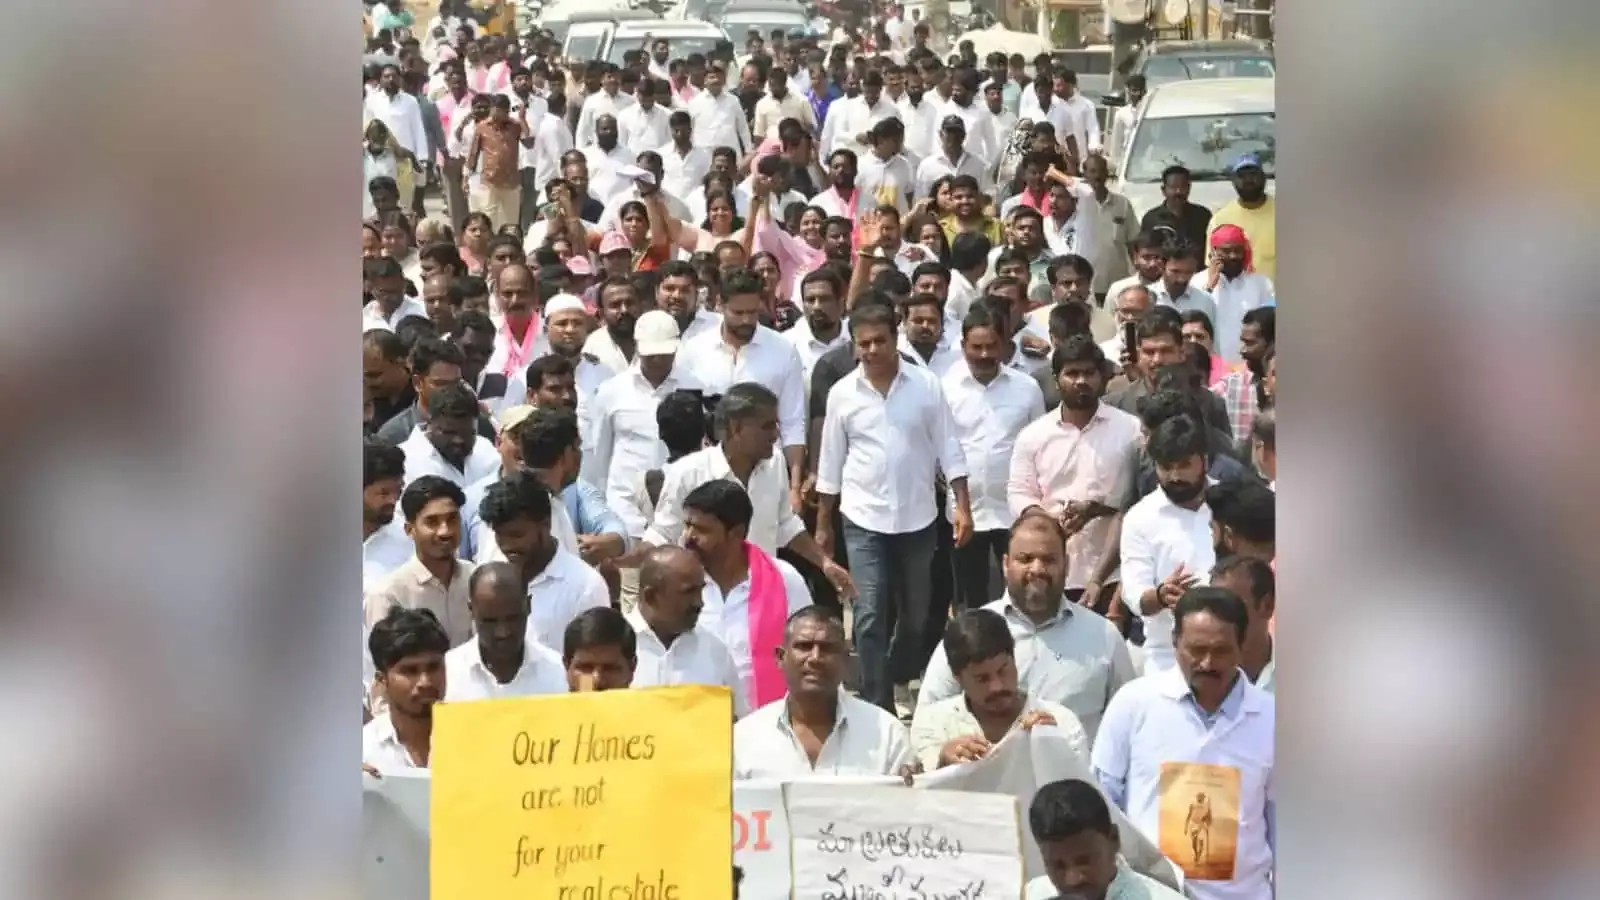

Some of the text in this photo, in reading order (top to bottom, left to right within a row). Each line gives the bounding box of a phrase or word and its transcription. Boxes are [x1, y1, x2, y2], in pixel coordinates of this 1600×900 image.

[512, 723, 656, 766] Our Homes
[521, 776, 607, 810] are not
[512, 834, 608, 878] for your
